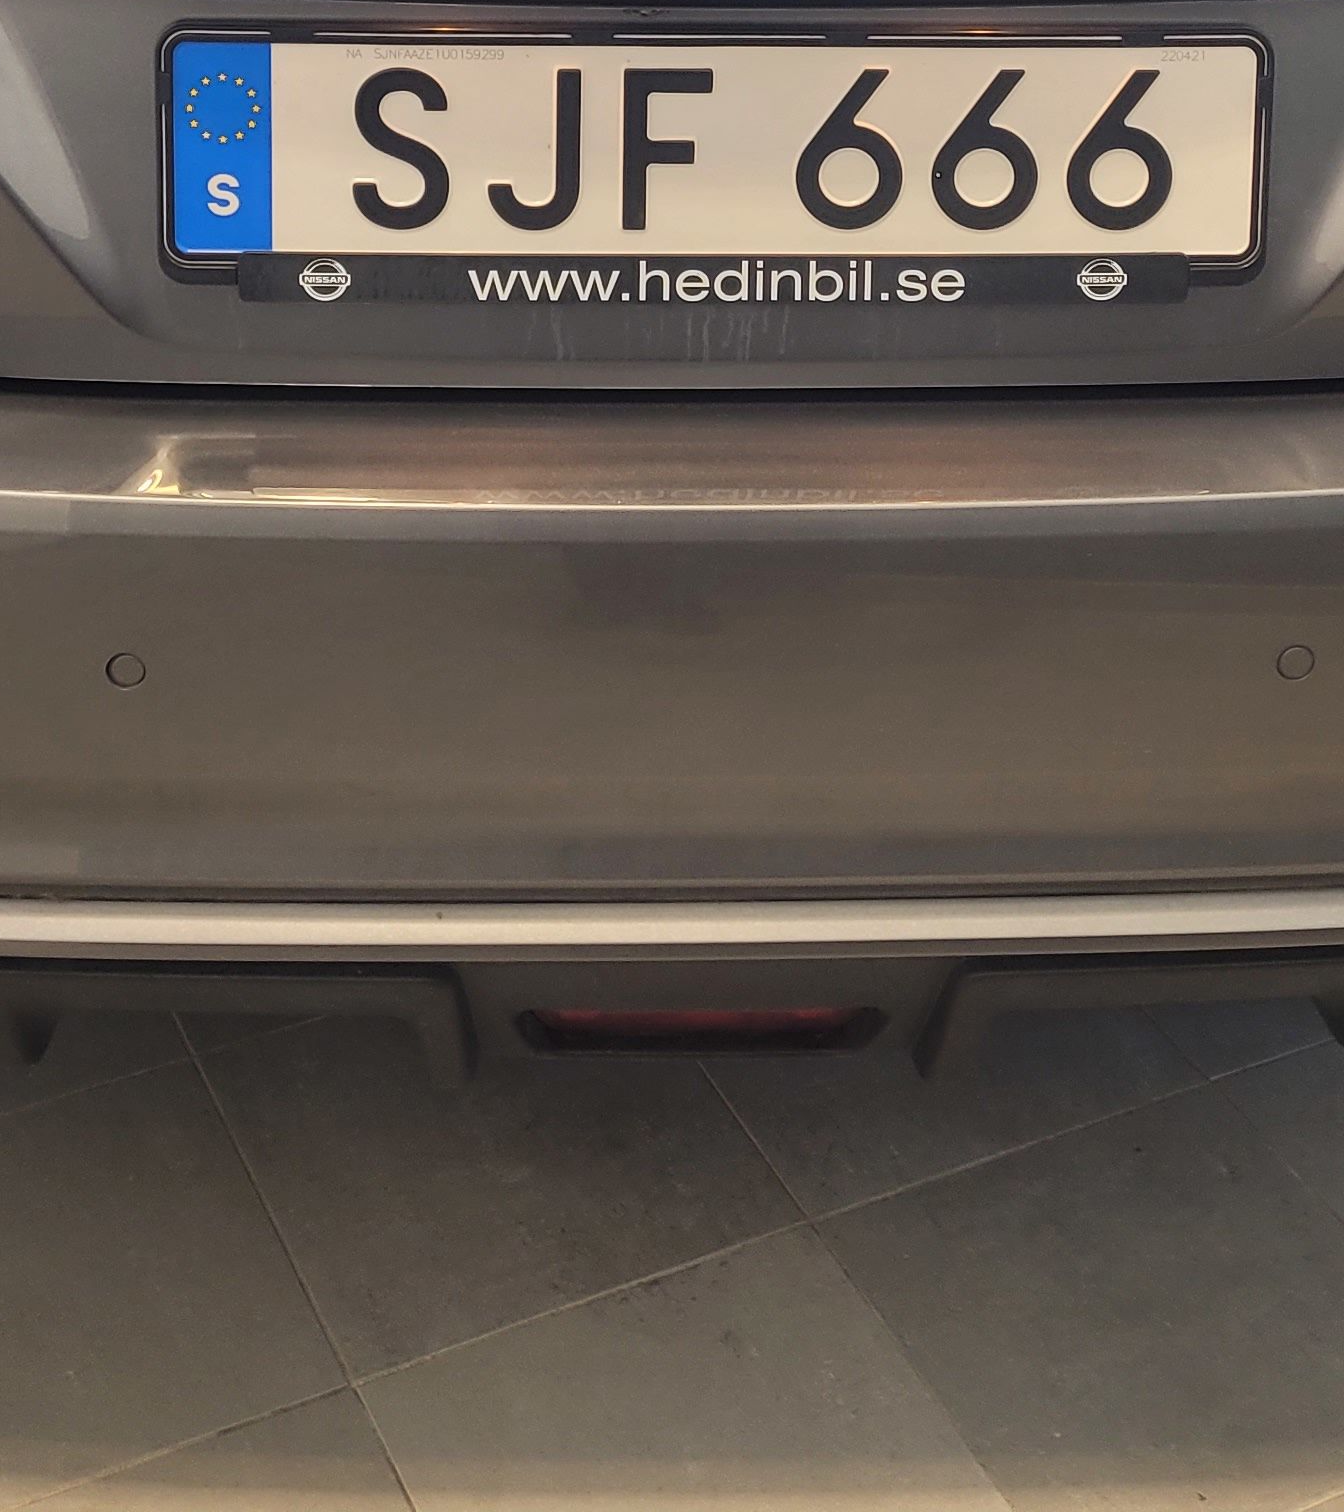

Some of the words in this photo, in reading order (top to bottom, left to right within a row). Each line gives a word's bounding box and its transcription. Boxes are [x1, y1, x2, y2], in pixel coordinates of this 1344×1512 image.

[1161, 49, 1205, 62] 220421
[352, 67, 714, 233] SJF
[794, 68, 1173, 234] 666
[207, 174, 240, 218] S
[304, 276, 346, 284] NISSAN
[467, 260, 966, 302] www.hedinbil.se
[1081, 276, 1123, 284] NISSAN
